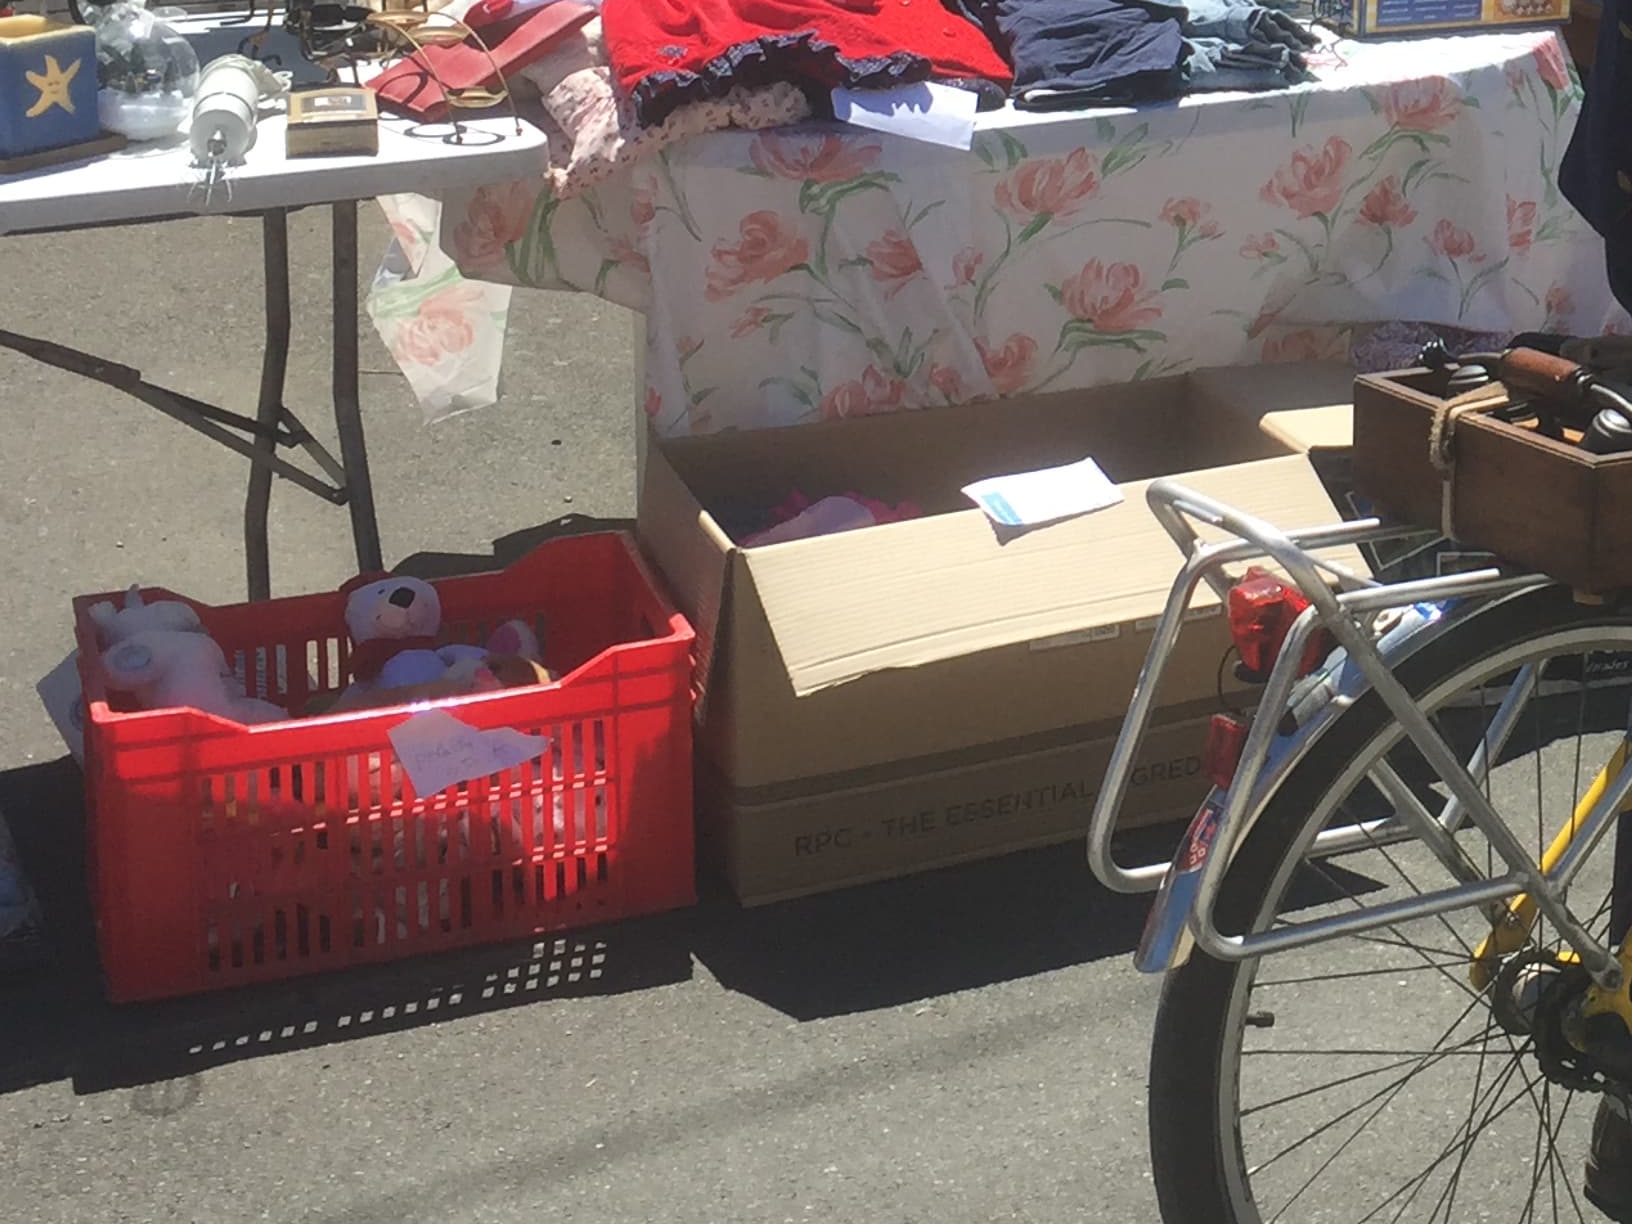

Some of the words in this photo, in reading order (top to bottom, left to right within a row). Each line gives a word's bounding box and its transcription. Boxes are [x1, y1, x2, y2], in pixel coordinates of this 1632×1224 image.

[795, 828, 853, 857] RPC
[880, 812, 936, 838] THE
[946, 782, 1094, 825] ESSENTIAL
